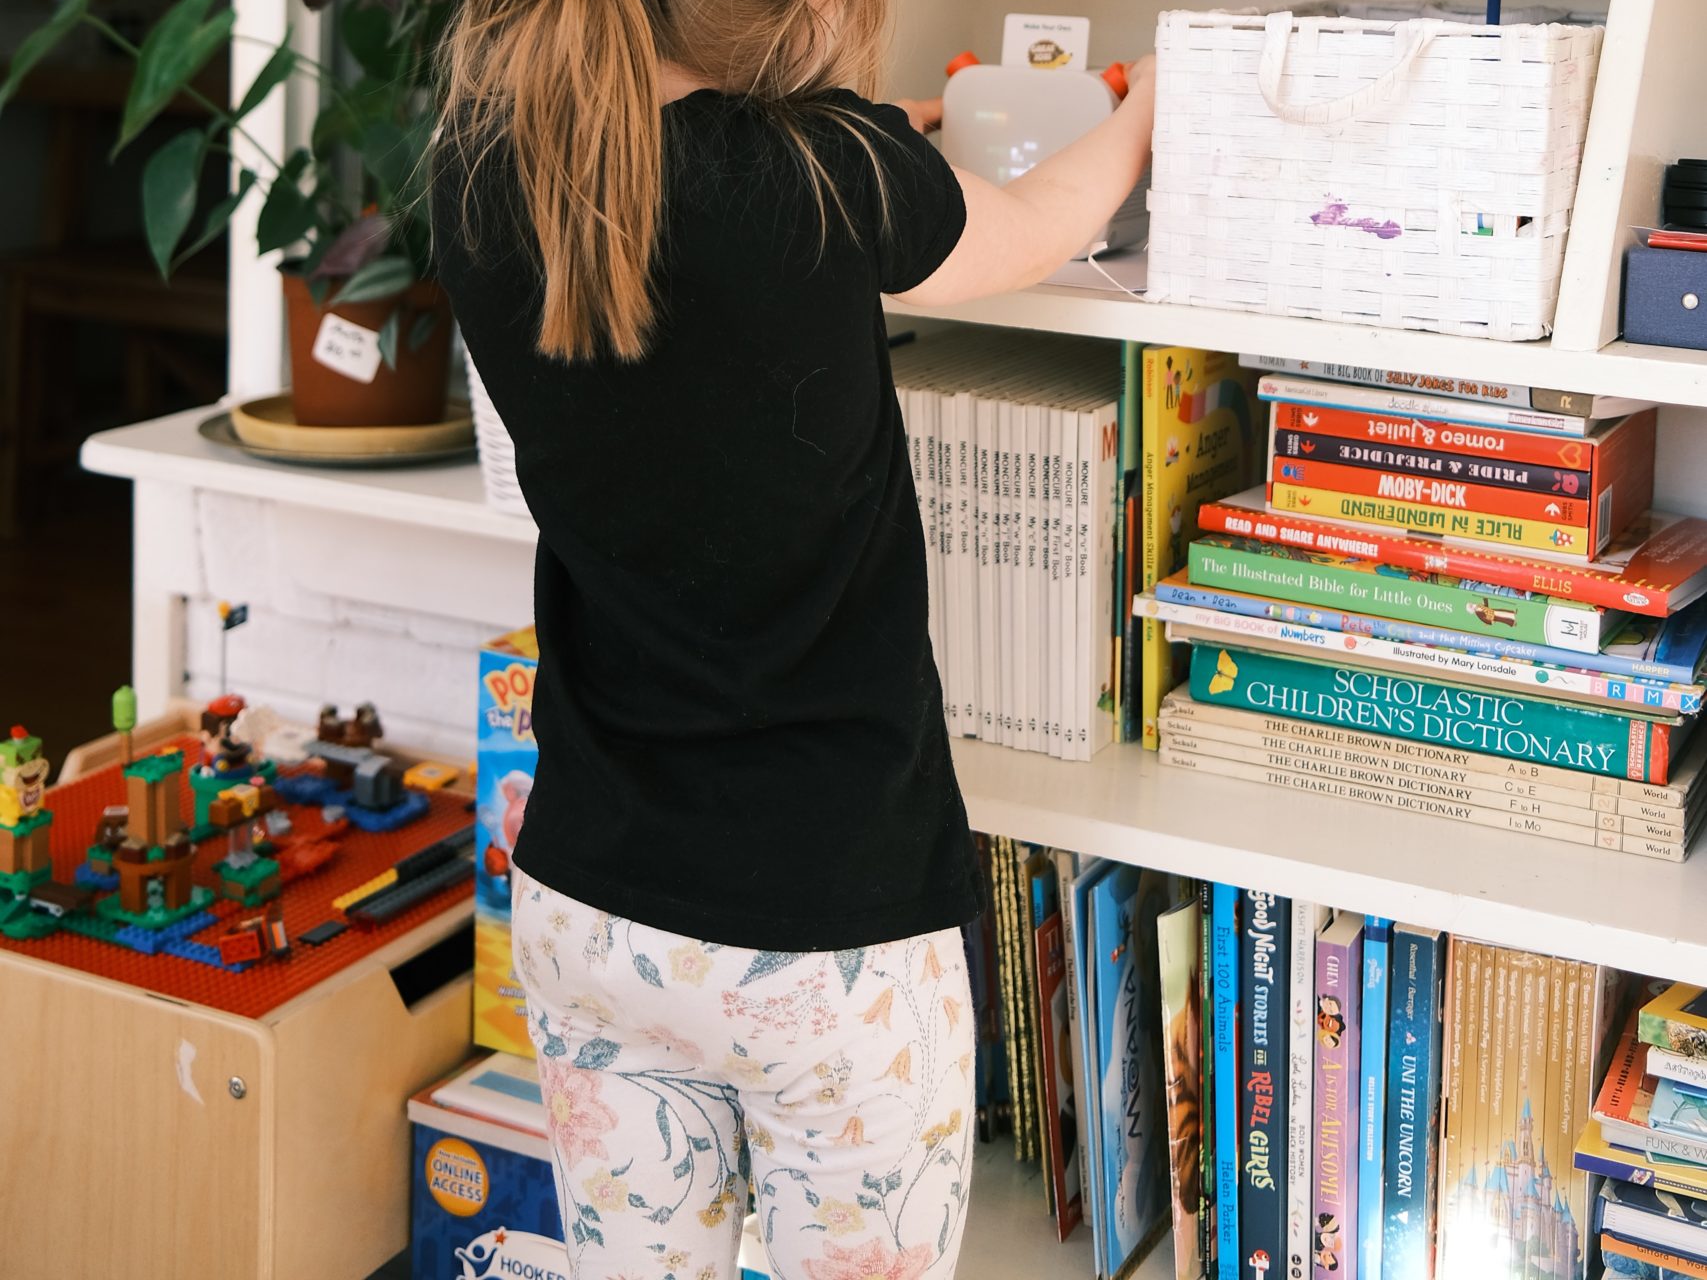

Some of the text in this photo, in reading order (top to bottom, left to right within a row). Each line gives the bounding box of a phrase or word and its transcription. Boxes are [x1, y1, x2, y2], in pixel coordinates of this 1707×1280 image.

[1323, 363, 1335, 376] THE
[1337, 365, 1350, 378] BIG
[1353, 367, 1371, 382] BOOK
[1375, 370, 1384, 383] OF
[1417, 375, 1453, 392] JOKES
[1458, 381, 1478, 395] FOR
[1196, 424, 1231, 459] Anger
[1368, 419, 1505, 452] romeo & juliet
[1052, 454, 1060, 500] MONCURE
[1339, 445, 1528, 484] PRIDE & PREJUDICE
[1377, 474, 1467, 507] MOBY-DICK
[1052, 518, 1060, 530] My
[1080, 460, 1088, 577] MONCURE My Book
[1146, 483, 1155, 540] Management
[1052, 558, 1060, 581] Book
[1146, 541, 1155, 569] Skills
[1224, 516, 1573, 594] READ AND SHARE ANYWHERE! ELLIS
[1202, 557, 1454, 613] The Illustrated Bible for Little Ones
[1171, 587, 1670, 677] Dean Dean Pete the Cat and the Missing Cupcakes HARPER
[1195, 611, 1696, 709] my BIG BOOK of Numbers Illustrated by Mary Lonsdale BRIMAX
[1333, 670, 1524, 726] SCHOLASTIC
[1247, 681, 1616, 772] CHILDREN'S DICTIONARY
[1637, 721, 1645, 769] REFERENCE
[1171, 738, 1671, 838] Schulz THE CHARLIE BROWN DICTIONARY F H World
[1265, 720, 1668, 800] THE CHARLIE BROWN DICTIONARY A B World
[1297, 904, 1308, 986] VASHTI HARRISON
[1326, 955, 1340, 988] CHEN
[1408, 943, 1419, 980] Rosenthal
[1252, 984, 1269, 1046] STORIES
[1123, 964, 1143, 1139] MOANA
[1217, 926, 1235, 1245] First 100 Animals Helen Parker
[1247, 1071, 1275, 1128] REBEL
[1319, 1056, 1343, 1206] A FOR AWESOME!
[1397, 1055, 1417, 1199] UNI THE UNICORN
[1645, 1136, 1680, 1153] FUNK
[1681, 1142, 1692, 1157] &
[431, 1176, 483, 1203] ACCESS
[432, 1159, 482, 1184] ONLINE
